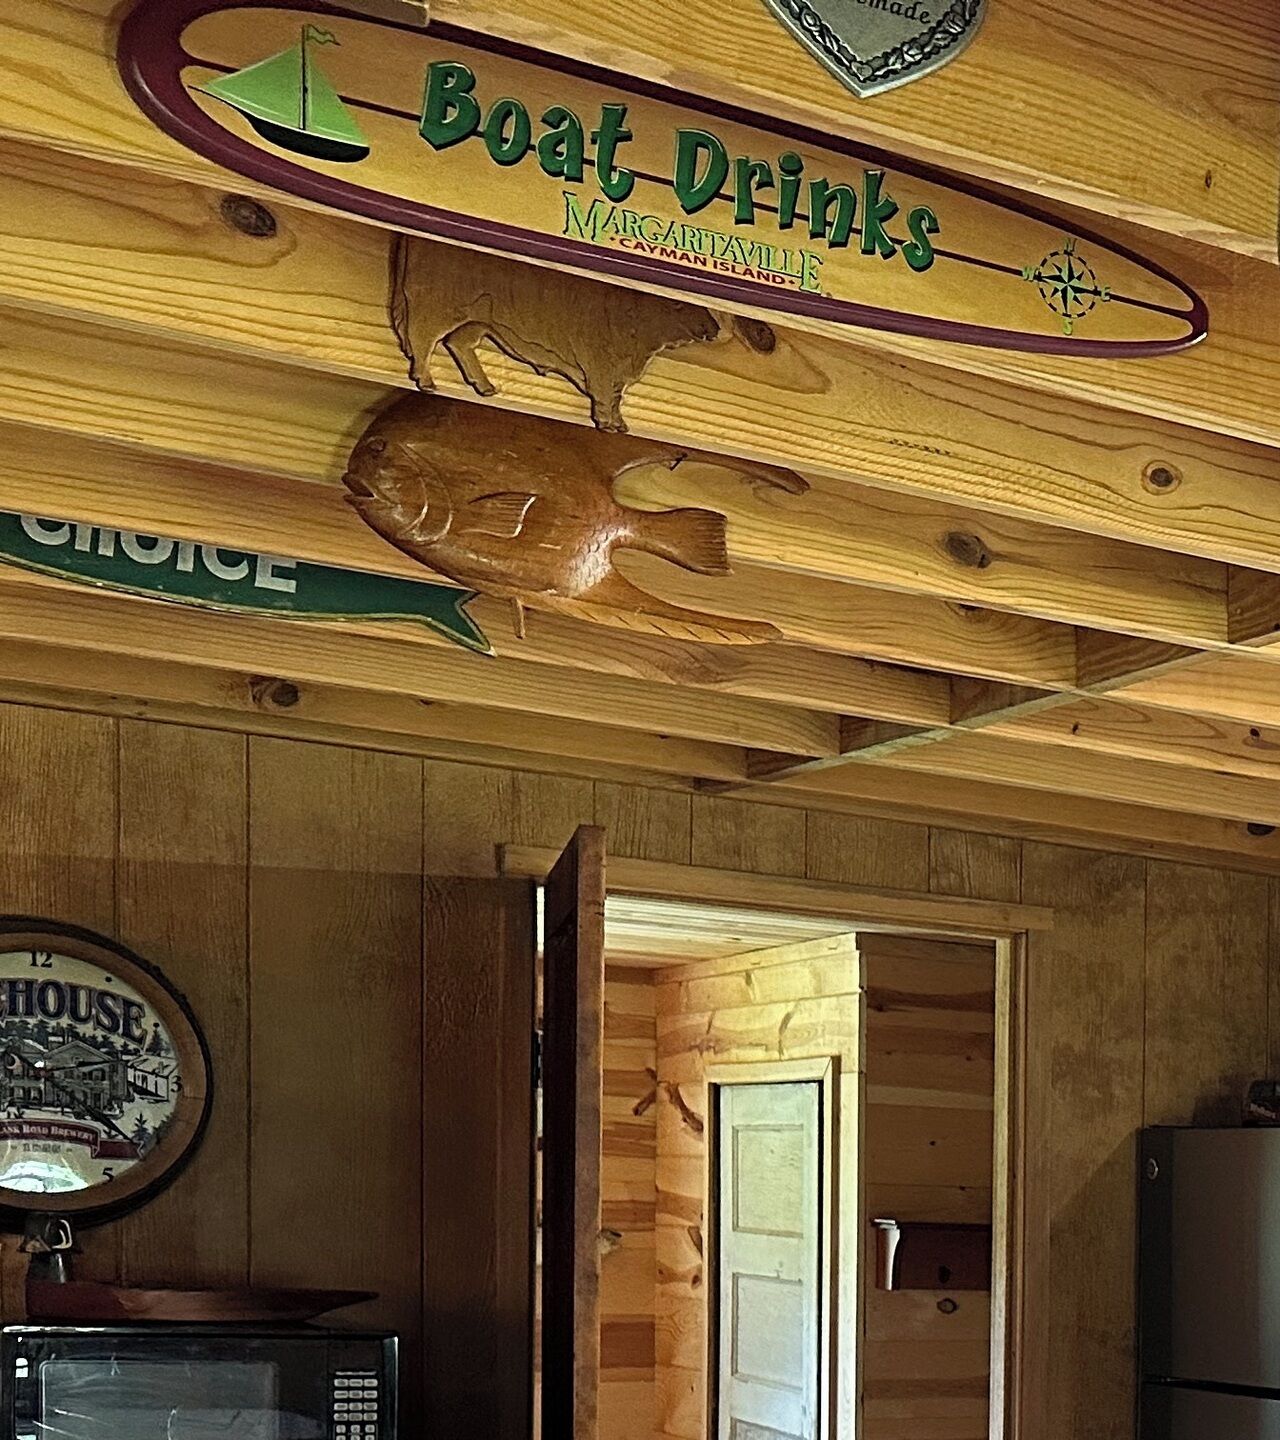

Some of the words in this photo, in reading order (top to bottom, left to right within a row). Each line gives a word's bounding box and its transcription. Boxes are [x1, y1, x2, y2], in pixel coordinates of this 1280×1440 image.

[857, 0, 930, 24] made
[418, 60, 636, 203] Boat
[673, 127, 940, 273] Drinks
[563, 191, 824, 296] MARGARITAVILLE
[619, 238, 707, 267] CAYMAN
[713, 260, 785, 286] ISLAND
[30, 951, 53, 968] 12
[0, 978, 147, 1050] HOUSE
